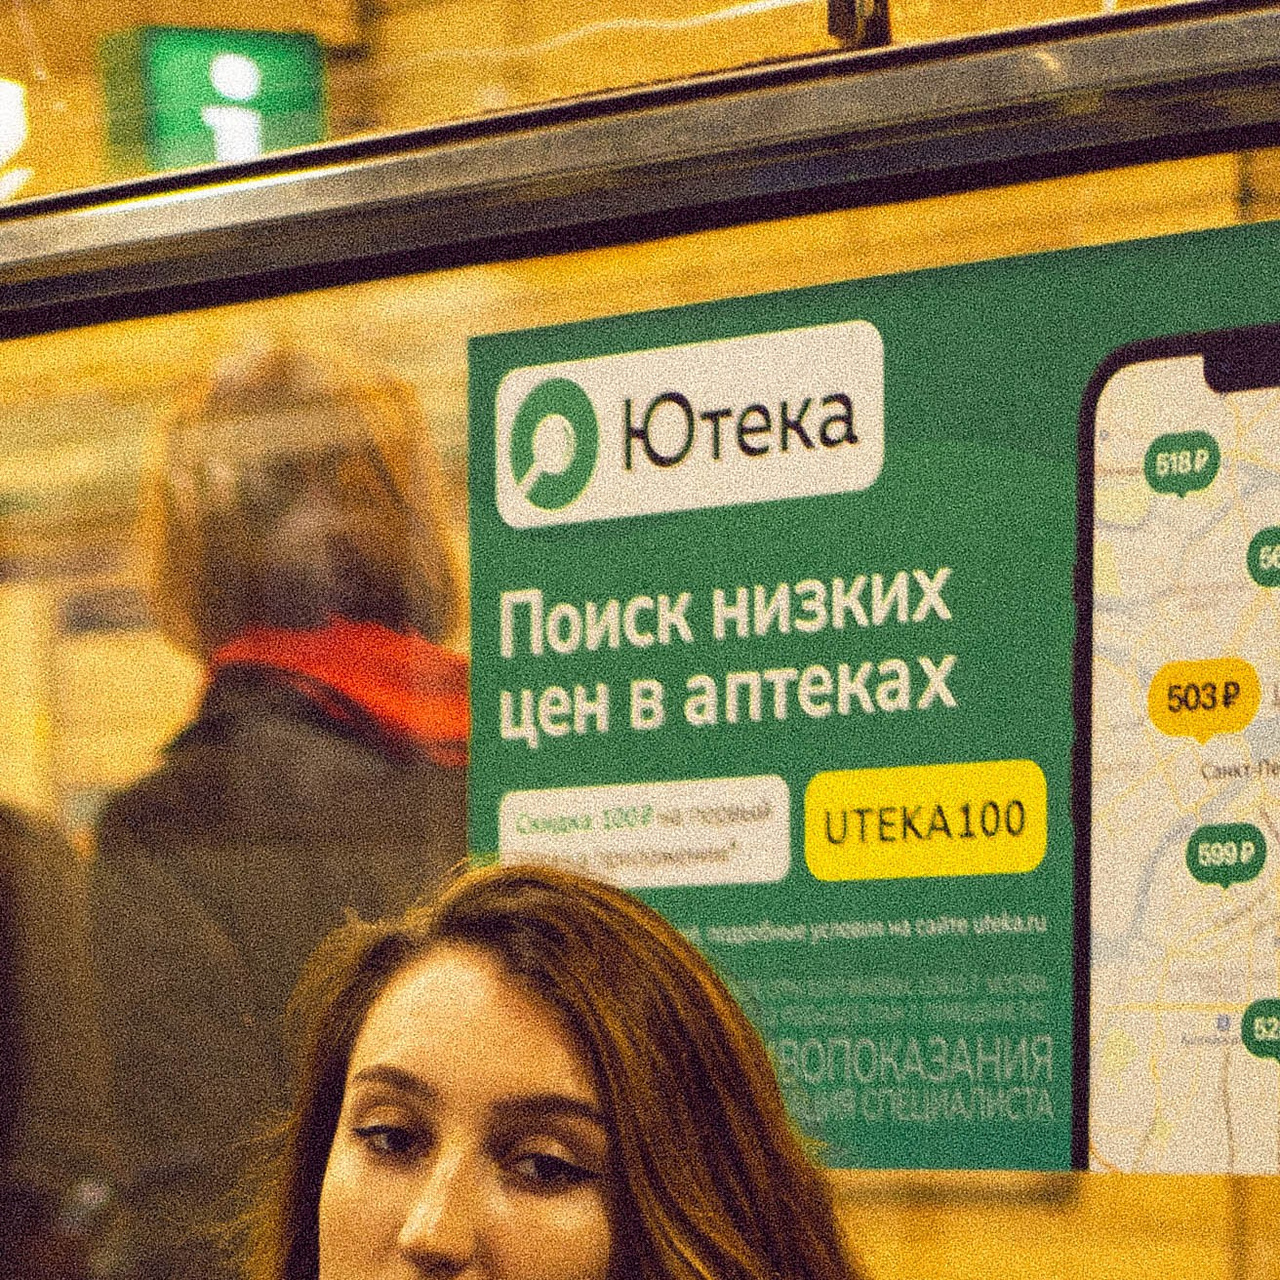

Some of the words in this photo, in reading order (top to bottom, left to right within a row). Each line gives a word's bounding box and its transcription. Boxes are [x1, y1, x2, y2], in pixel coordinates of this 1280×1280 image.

[624, 391, 859, 471] Ютека
[499, 588, 695, 660] Поиск
[713, 566, 954, 642] низких
[500, 682, 612, 750] цен
[630, 677, 665, 732] в
[684, 654, 959, 727] аптеках
[824, 800, 1027, 846] UTEKA100
[915, 914, 968, 936] сайте
[973, 910, 1047, 934] uteka.ru
[777, 1034, 1053, 1084] ВОПОКАЗАНИЯ
